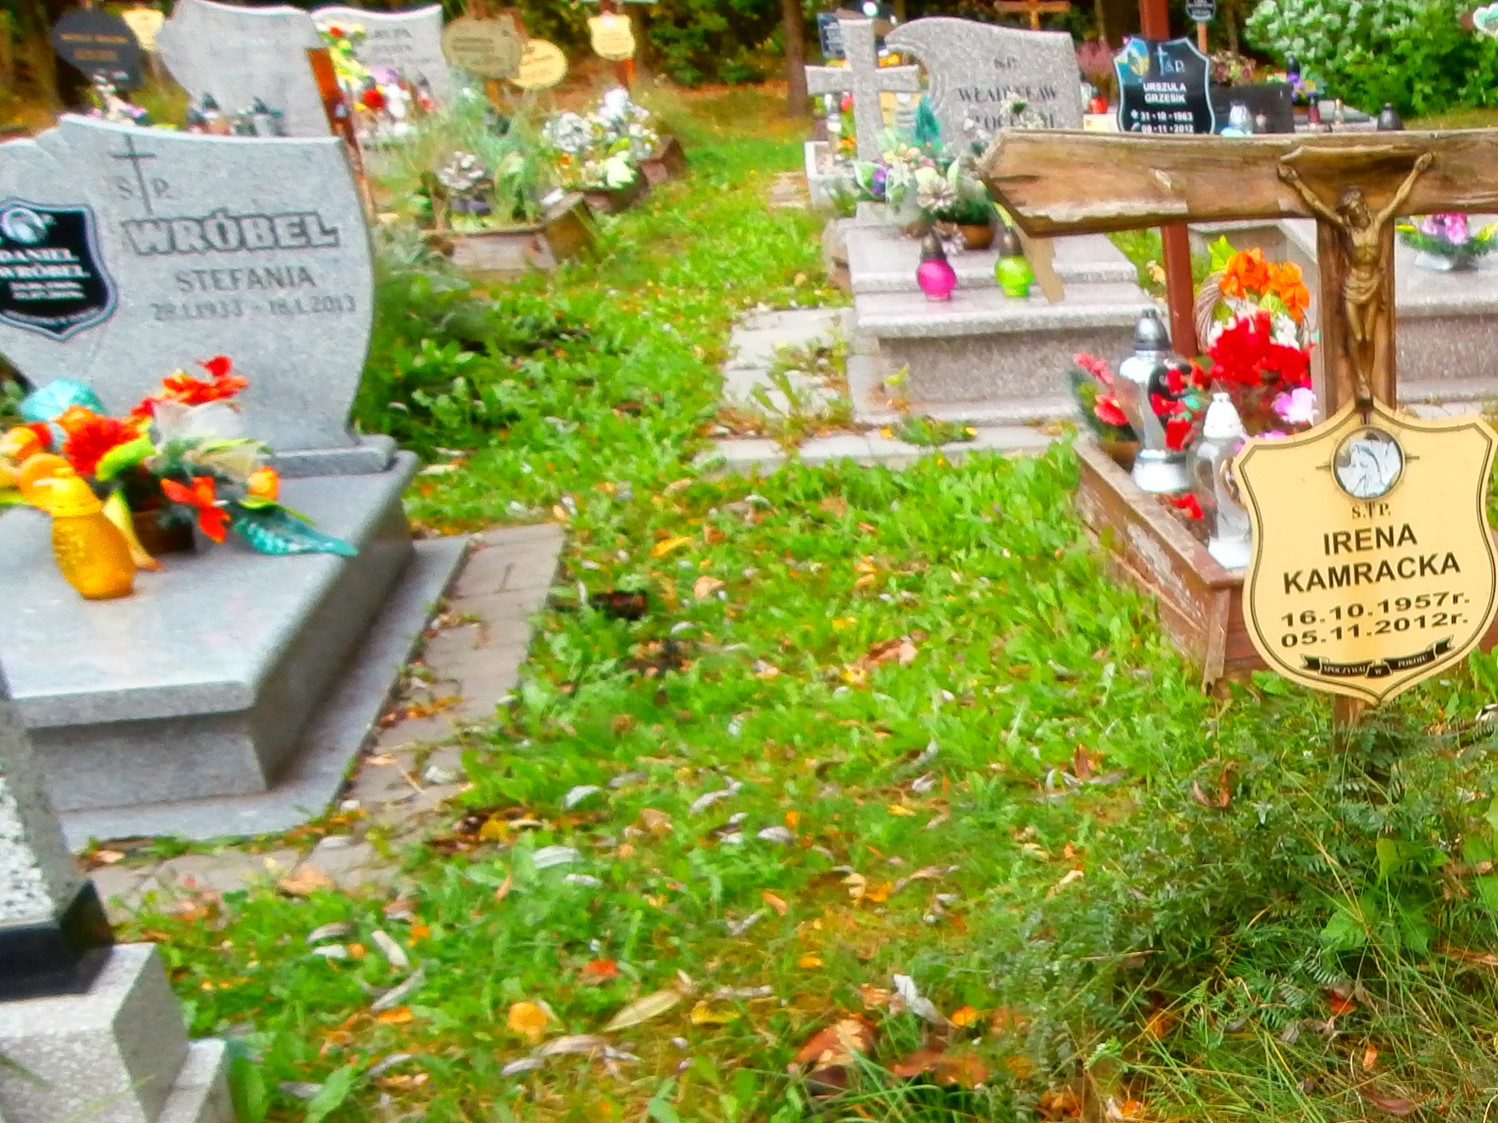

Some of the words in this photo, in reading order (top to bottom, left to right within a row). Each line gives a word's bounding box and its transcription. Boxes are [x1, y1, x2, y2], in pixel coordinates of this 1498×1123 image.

[1142, 82, 1187, 92] URSZULA
[121, 206, 340, 256] WRÓBEL
[174, 266, 316, 293] STEFANIA
[1323, 523, 1418, 556] IRENA
[1283, 552, 1461, 595] KAMRACKA
[1280, 591, 1470, 628] 16.10.1957r.
[1280, 612, 1468, 648] 05.11.2012r.
[1374, 667, 1383, 675] W
[1397, 654, 1429, 668] POKOJU
